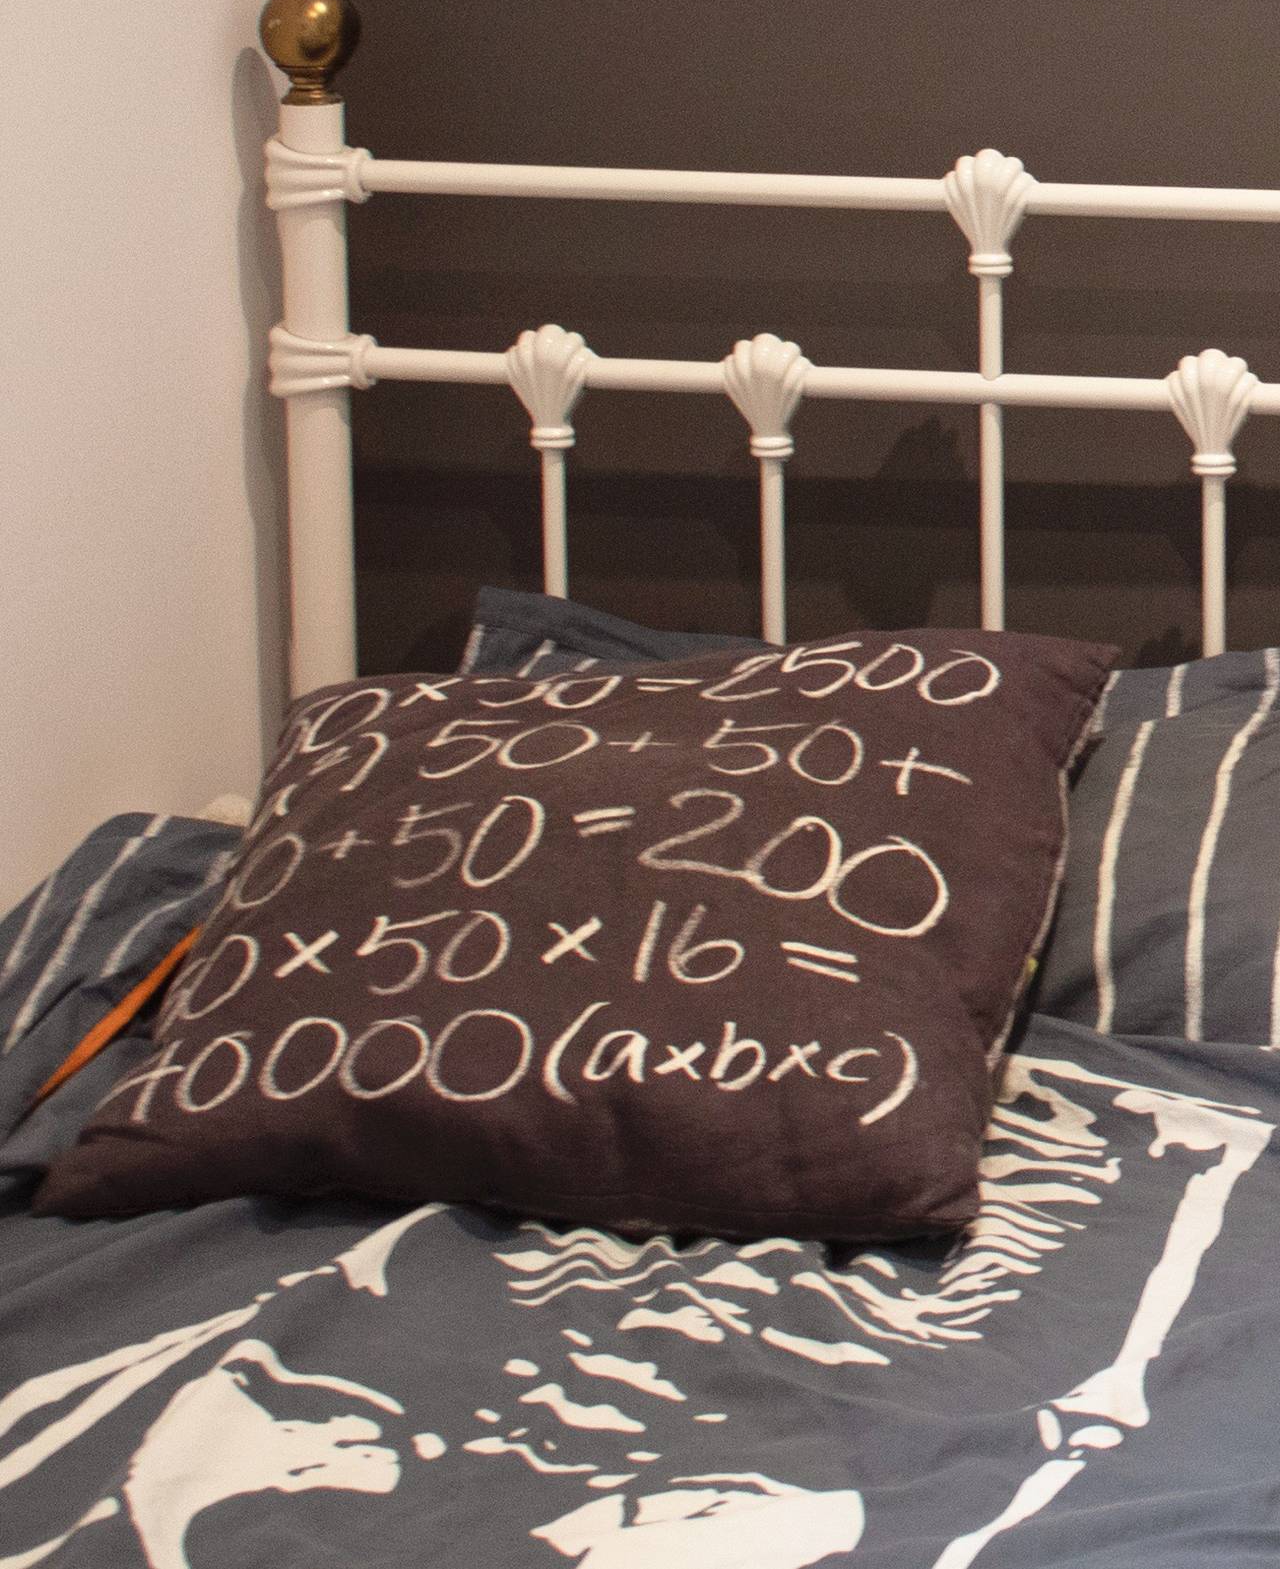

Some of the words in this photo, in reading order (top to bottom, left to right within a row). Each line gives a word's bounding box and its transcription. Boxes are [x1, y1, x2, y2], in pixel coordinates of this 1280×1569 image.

[701, 640, 1002, 706] 2500
[418, 718, 599, 779] 50
[703, 718, 865, 786] 50
[391, 795, 546, 888] 50
[636, 787, 950, 938] 200
[355, 909, 511, 996] 50
[632, 899, 745, 985] 16
